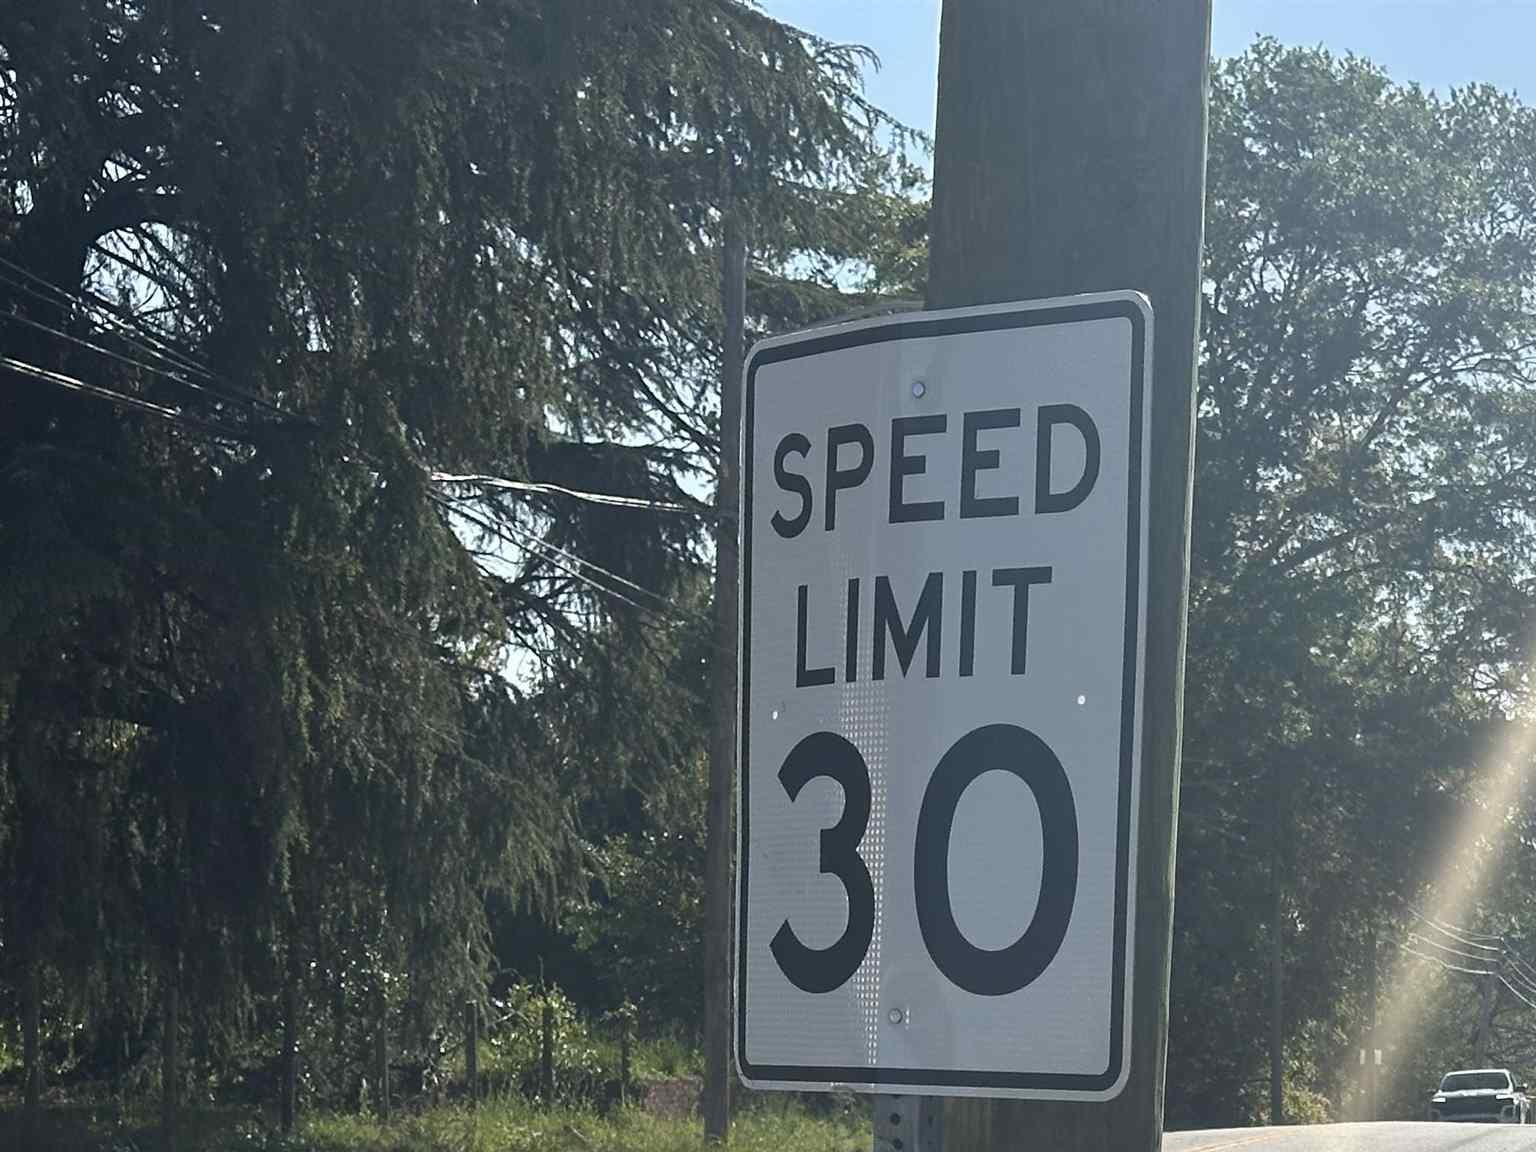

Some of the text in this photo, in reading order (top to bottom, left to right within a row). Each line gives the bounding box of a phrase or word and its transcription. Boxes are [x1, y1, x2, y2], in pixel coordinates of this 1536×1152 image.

[770, 403, 1101, 538] SPEED
[795, 566, 1053, 688] LIMIT
[768, 723, 1080, 997] 30
